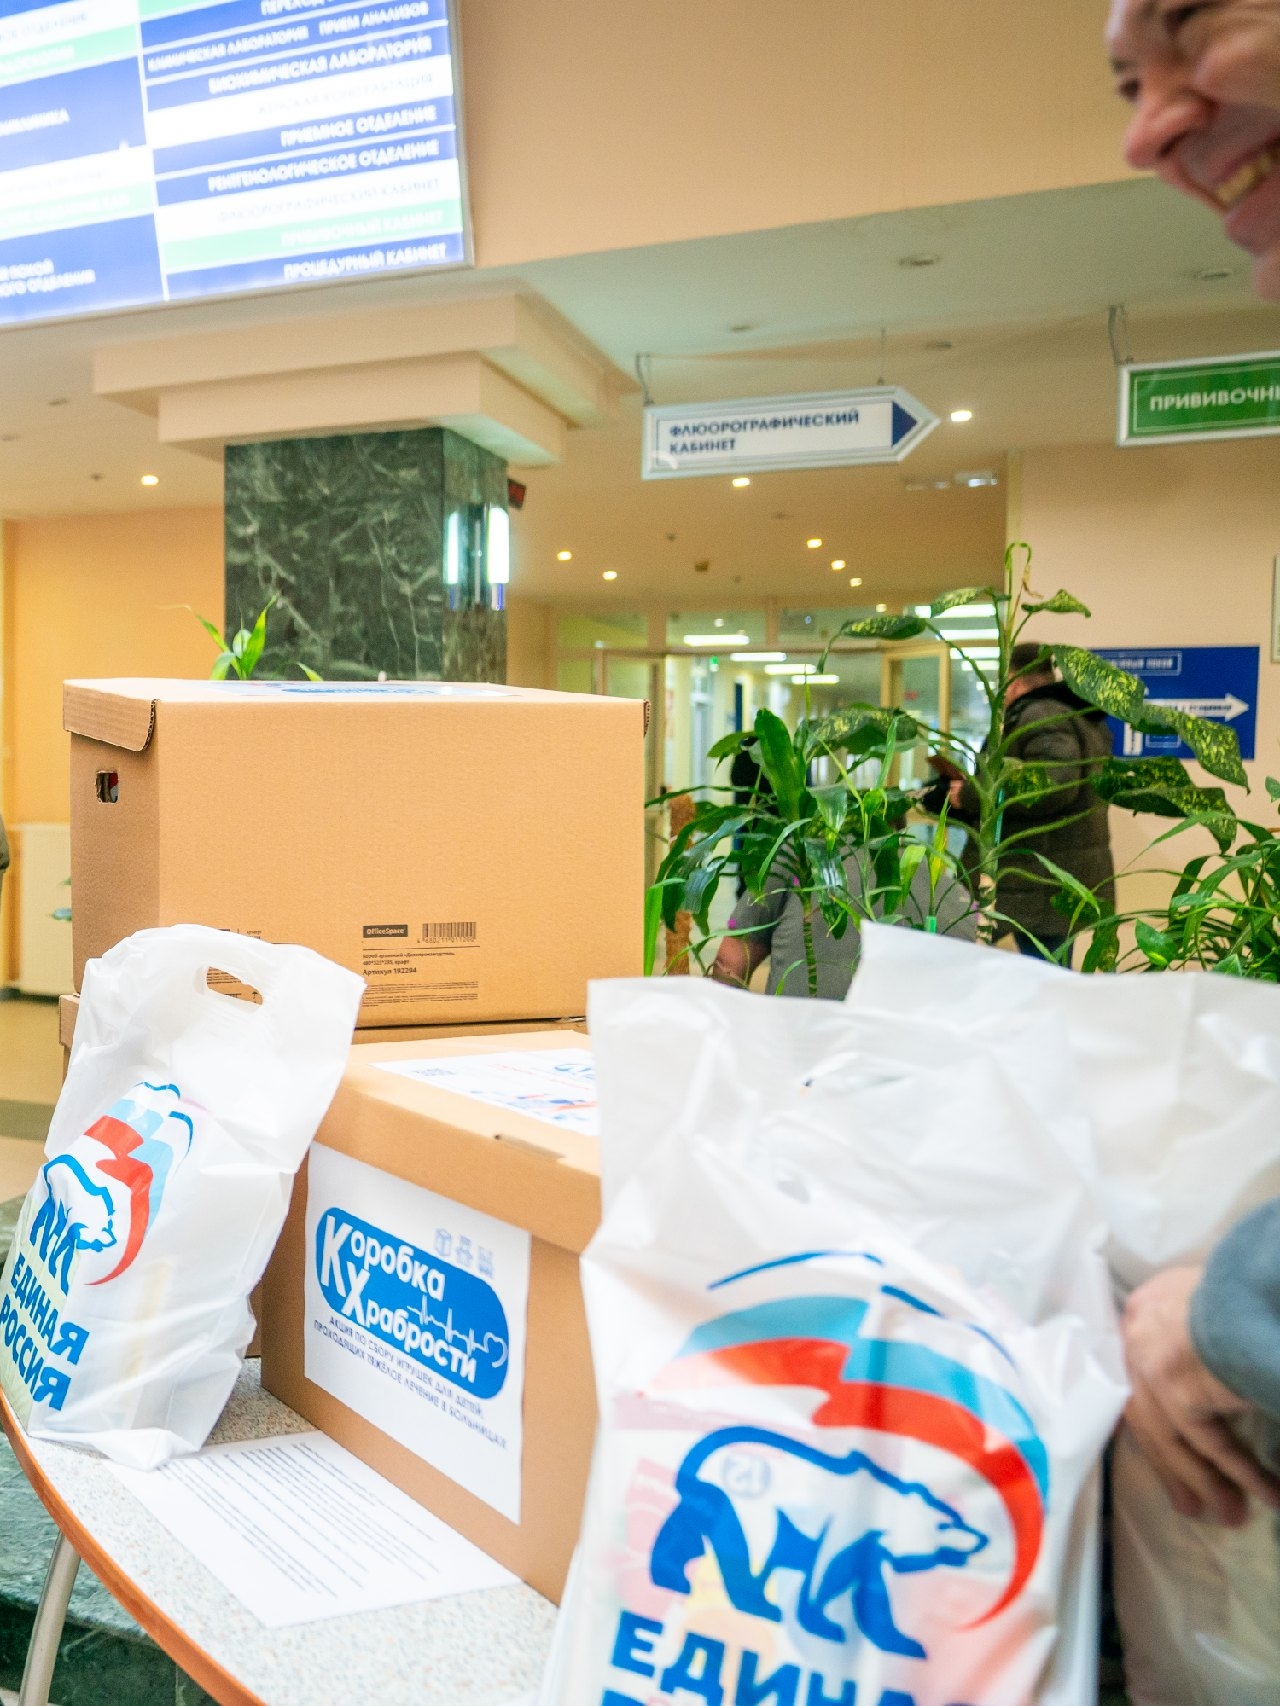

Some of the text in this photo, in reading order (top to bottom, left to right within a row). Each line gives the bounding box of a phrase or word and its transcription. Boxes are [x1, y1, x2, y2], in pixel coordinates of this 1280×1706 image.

[209, 36, 432, 94] БИОХИМИЧЕСКАЯ ЛАБОРАТОРИЯ
[281, 105, 437, 147] ПРИЕМНОЕ ОТДЕЛЕНИЕ
[209, 139, 439, 192] РЕНТГЕНОЛОГИЧЕСКОЕ ОТДЕЛЕНИЕ
[284, 243, 446, 280] ПРОЦЕДУРНЫЙ КАБИНЕТ
[670, 408, 859, 436] ФЛЮОРОГРАФИЧЕСКИЙ
[670, 438, 736, 455] КАБИНЕТ
[366, 926, 405, 935] OfficeSpace
[363, 968, 392, 976] Артикул
[321, 1215, 446, 1301] Коробка
[10, 1252, 90, 1366] ЕДИНАЯ
[342, 1262, 477, 1383] Храбрости
[329, 1316, 353, 1338] АКЦИЯ
[355, 1331, 366, 1345] ПО
[368, 1339, 394, 1362] СБОРУ
[396, 1357, 433, 1387] ИГРУШЕК
[435, 1382, 453, 1398] ДЛЯ
[313, 1319, 365, 1360] ПРОХОДЯЩИХ
[404, 1377, 440, 1408] ЛЕЧЕНИЕ
[449, 1406, 507, 1449] БОЛЬНИЦАХ
